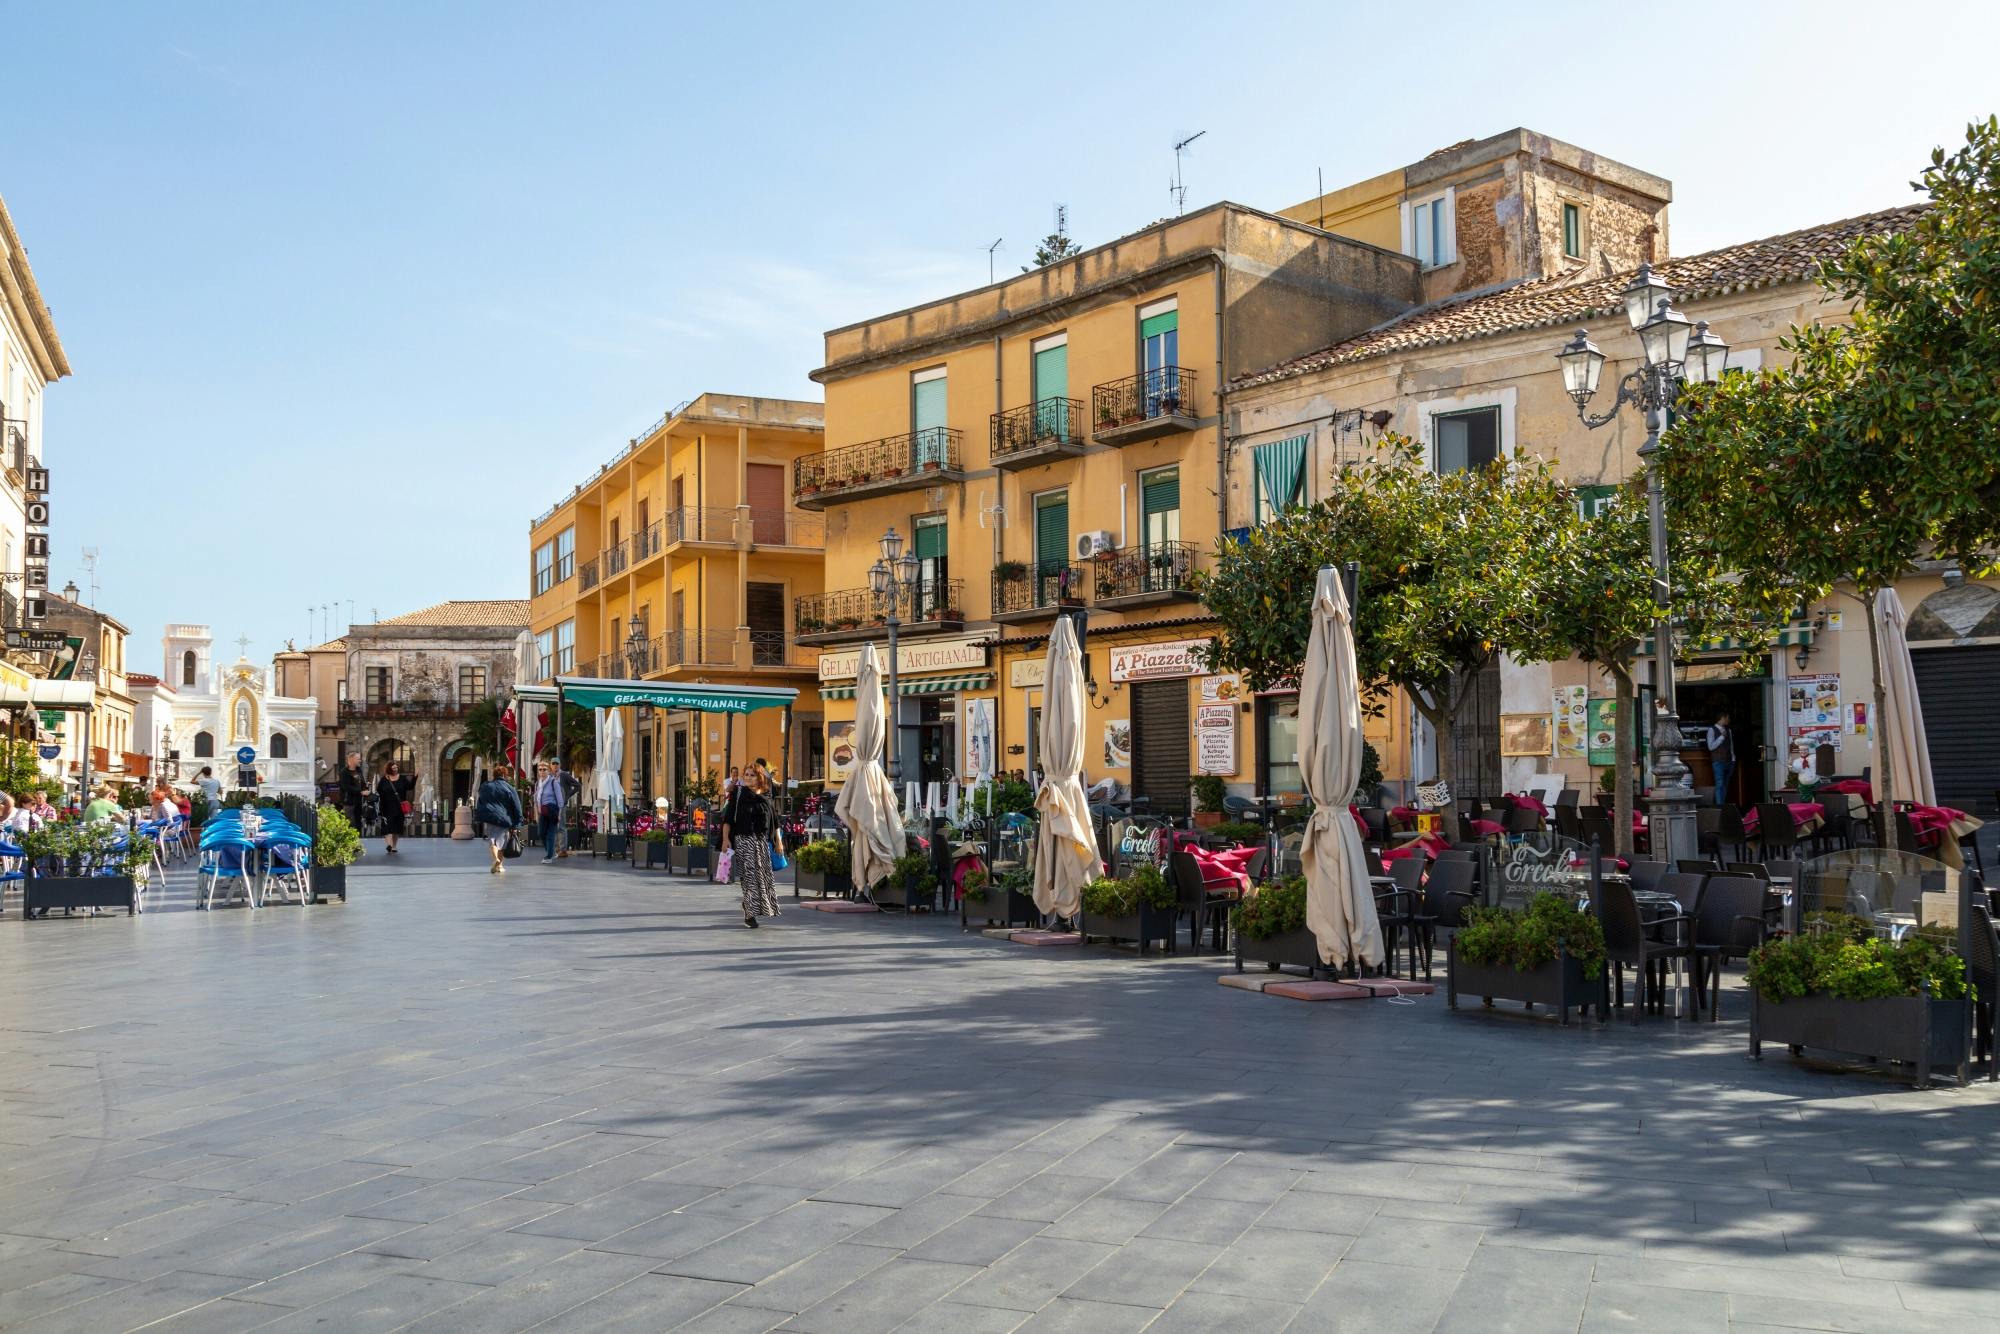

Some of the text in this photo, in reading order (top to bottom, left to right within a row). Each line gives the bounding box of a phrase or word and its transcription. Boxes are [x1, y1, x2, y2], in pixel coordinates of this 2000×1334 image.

[28, 471, 47, 619] HOTEL
[20, 638, 65, 649] Murat
[821, 647, 983, 677] GELATA ARTIGIANALE
[1203, 678, 1223, 686] POLLO
[678, 697, 748, 711] ARTIGIANALE
[1205, 706, 1232, 718] Piazzetta
[1122, 826, 1160, 853] Ercole
[1505, 847, 1573, 883] Ercole
